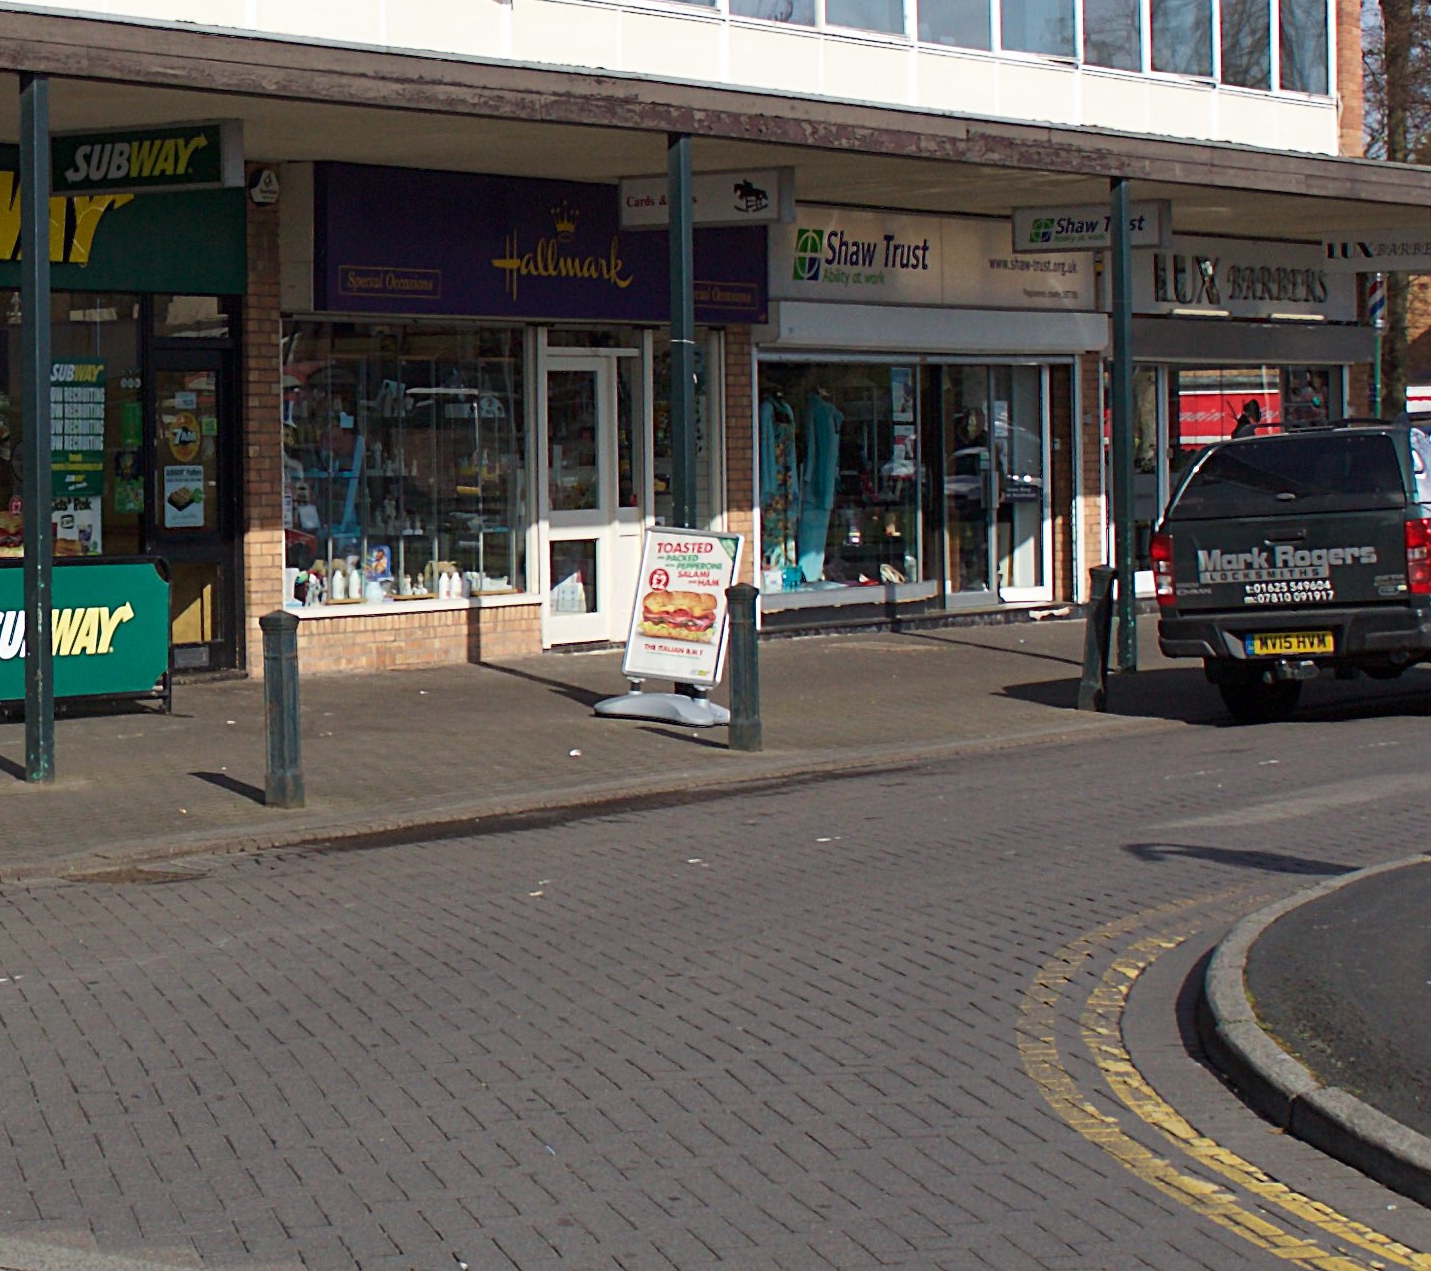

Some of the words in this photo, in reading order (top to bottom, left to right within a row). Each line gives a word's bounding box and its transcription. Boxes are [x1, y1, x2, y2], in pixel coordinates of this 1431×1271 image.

[64, 132, 209, 184] SUBWAY
[626, 195, 655, 208] Cards
[1056, 216, 1098, 234] Shaw
[1104, 215, 1144, 233] Tst
[826, 231, 877, 267] Shaw
[883, 235, 929, 270] Trust
[1327, 242, 1373, 258] LUX
[491, 228, 634, 301] Hallmark
[989, 258, 1078, 275] www.shaw-trust.org.uk
[385, 271, 434, 292] Occasions
[823, 269, 850, 286] Ability
[851, 273, 862, 285] at
[864, 271, 885, 285] work
[1154, 253, 1220, 305] LUX
[1227, 264, 1329, 304] BARBERS
[50, 363, 104, 383] SUBWAY
[656, 542, 714, 554] TOASTED
[1198, 547, 1269, 572] Mark
[1274, 545, 1378, 569] Rogers
[1208, 568, 1320, 582] LOCKSMITHS
[1293, 590, 1335, 602] 091917
[1259, 635, 1293, 650] MV15
